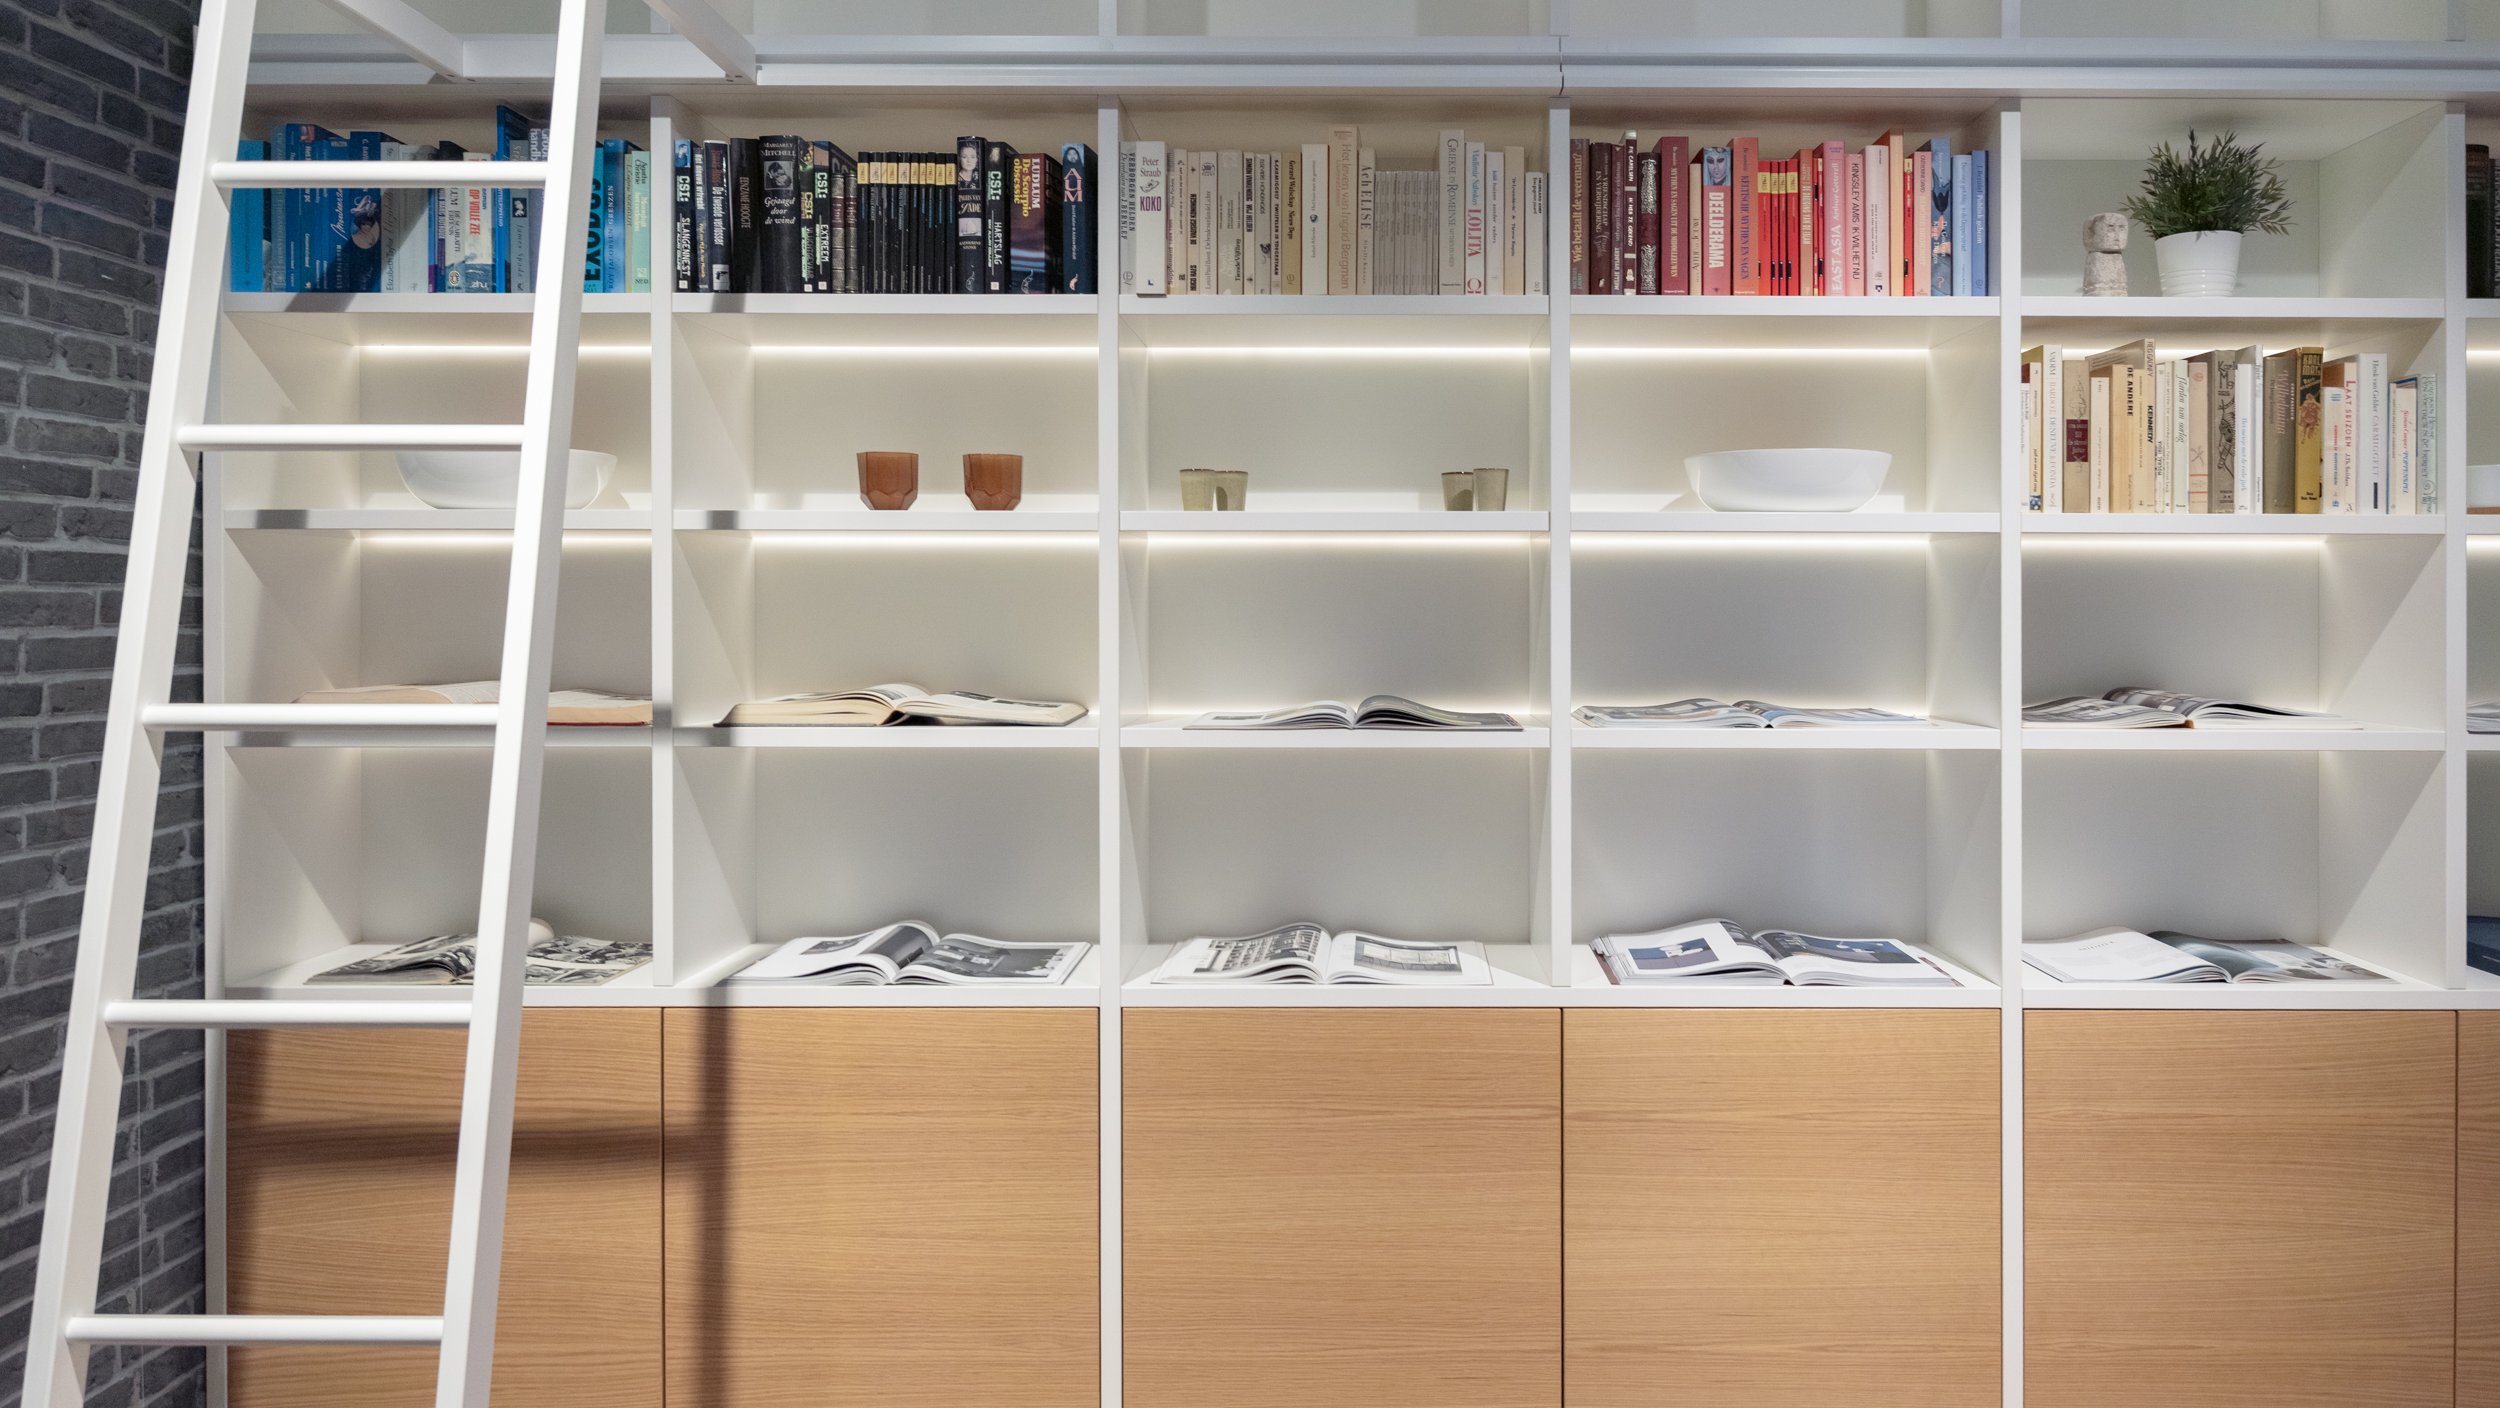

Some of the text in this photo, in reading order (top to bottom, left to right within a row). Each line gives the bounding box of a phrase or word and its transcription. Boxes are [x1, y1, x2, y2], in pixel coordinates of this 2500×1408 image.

[761, 149, 796, 157] MITCHELL
[1142, 156, 1159, 165] Peter
[817, 172, 828, 199] CSI:
[990, 171, 1002, 200] CSI:
[1014, 159, 1022, 204] obsessie
[1032, 158, 1040, 209] LUDLUM
[1064, 168, 1083, 202] AUM
[1140, 167, 1161, 176] Straub
[1852, 163, 1860, 201] KINGSLEY
[679, 175, 690, 202] CSI:
[740, 177, 750, 229] EENZAME HOOGTE
[764, 197, 796, 207] Gejaagd
[1020, 159, 1031, 217] De Scorpio
[1139, 196, 1162, 211] KOKO
[1360, 165, 1372, 230] Ach ELISE
[1594, 171, 1602, 233] EN VERWIJDERING
[1740, 176, 1749, 213] KELTISCHE
[469, 189, 480, 235] OP VOLLE ZEE
[712, 187, 725, 246] De tweede verlosser
[770, 207, 788, 215] door
[774, 216, 796, 225] wind
[1339, 144, 1352, 289] Het leven van Ingrid Bergman
[1447, 184, 1458, 227] ROMEINSE
[1852, 203, 1860, 223] AMIS
[994, 222, 1002, 265] HARTSLAG
[1467, 209, 1481, 257] LOLITA
[1572, 210, 1582, 249] betaalt
[1709, 192, 1724, 268] DEELDERAMA
[1740, 214, 1749, 245] MYTHEN
[1852, 235, 1860, 250] WIL
[682, 218, 690, 276] SLANGENNEST
[1572, 250, 1582, 263] Wie
[1831, 225, 1841, 291] EAST ASIA
[1852, 252, 1860, 267] HET
[1740, 257, 1749, 280] SAGEN
[1852, 268, 1860, 280] NU
[2127, 367, 2133, 378] DE
[2345, 380, 2356, 405] LAAT
